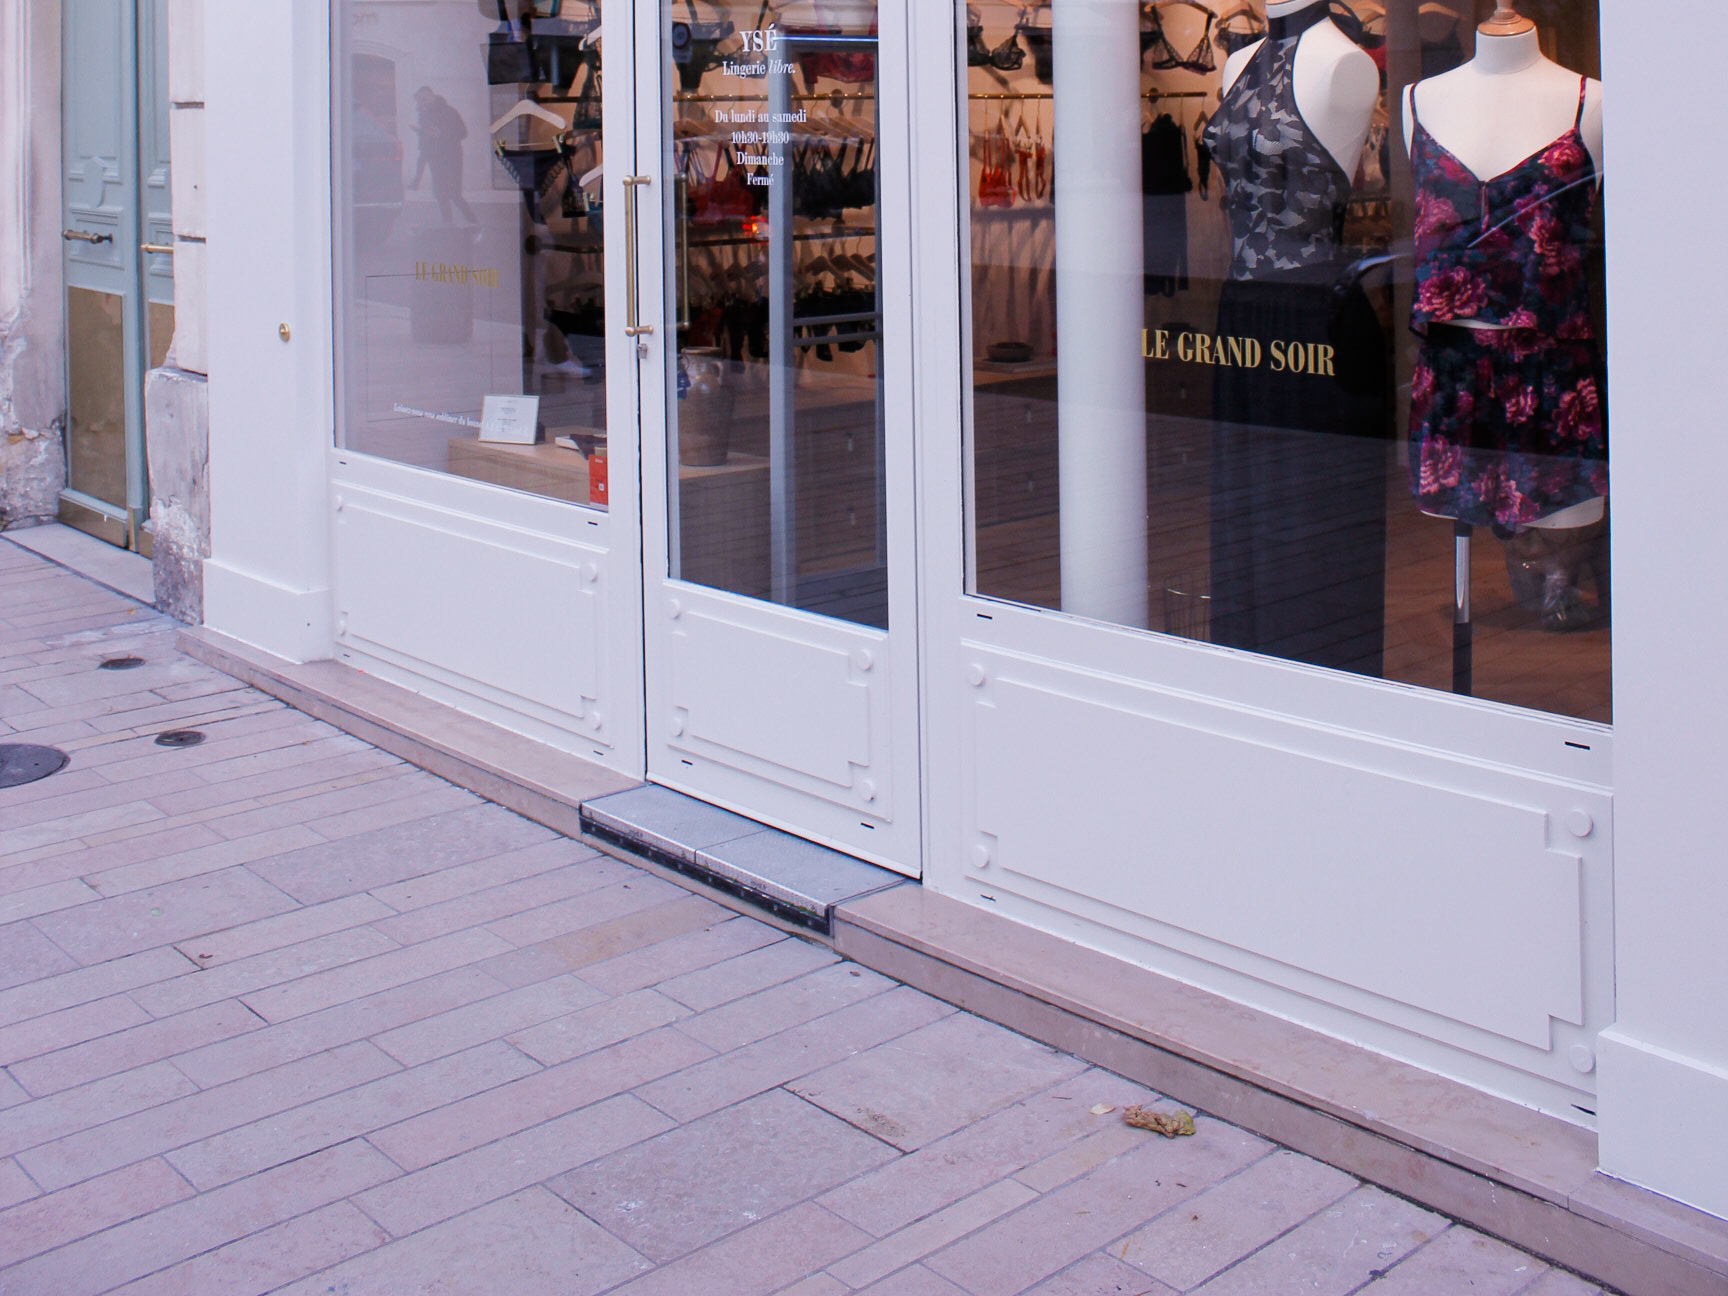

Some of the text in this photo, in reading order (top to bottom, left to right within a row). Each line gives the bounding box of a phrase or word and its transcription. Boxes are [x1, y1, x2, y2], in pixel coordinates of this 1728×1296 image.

[740, 23, 777, 52] YSÉ
[722, 59, 796, 78] Lingerie libre.
[714, 109, 807, 123] Du lundi au samedi
[731, 131, 789, 144] 10h30-19h30
[736, 152, 784, 166] Dimanche
[747, 173, 775, 186] Fermé
[1141, 328, 1336, 376] LE GRAND SOIR
